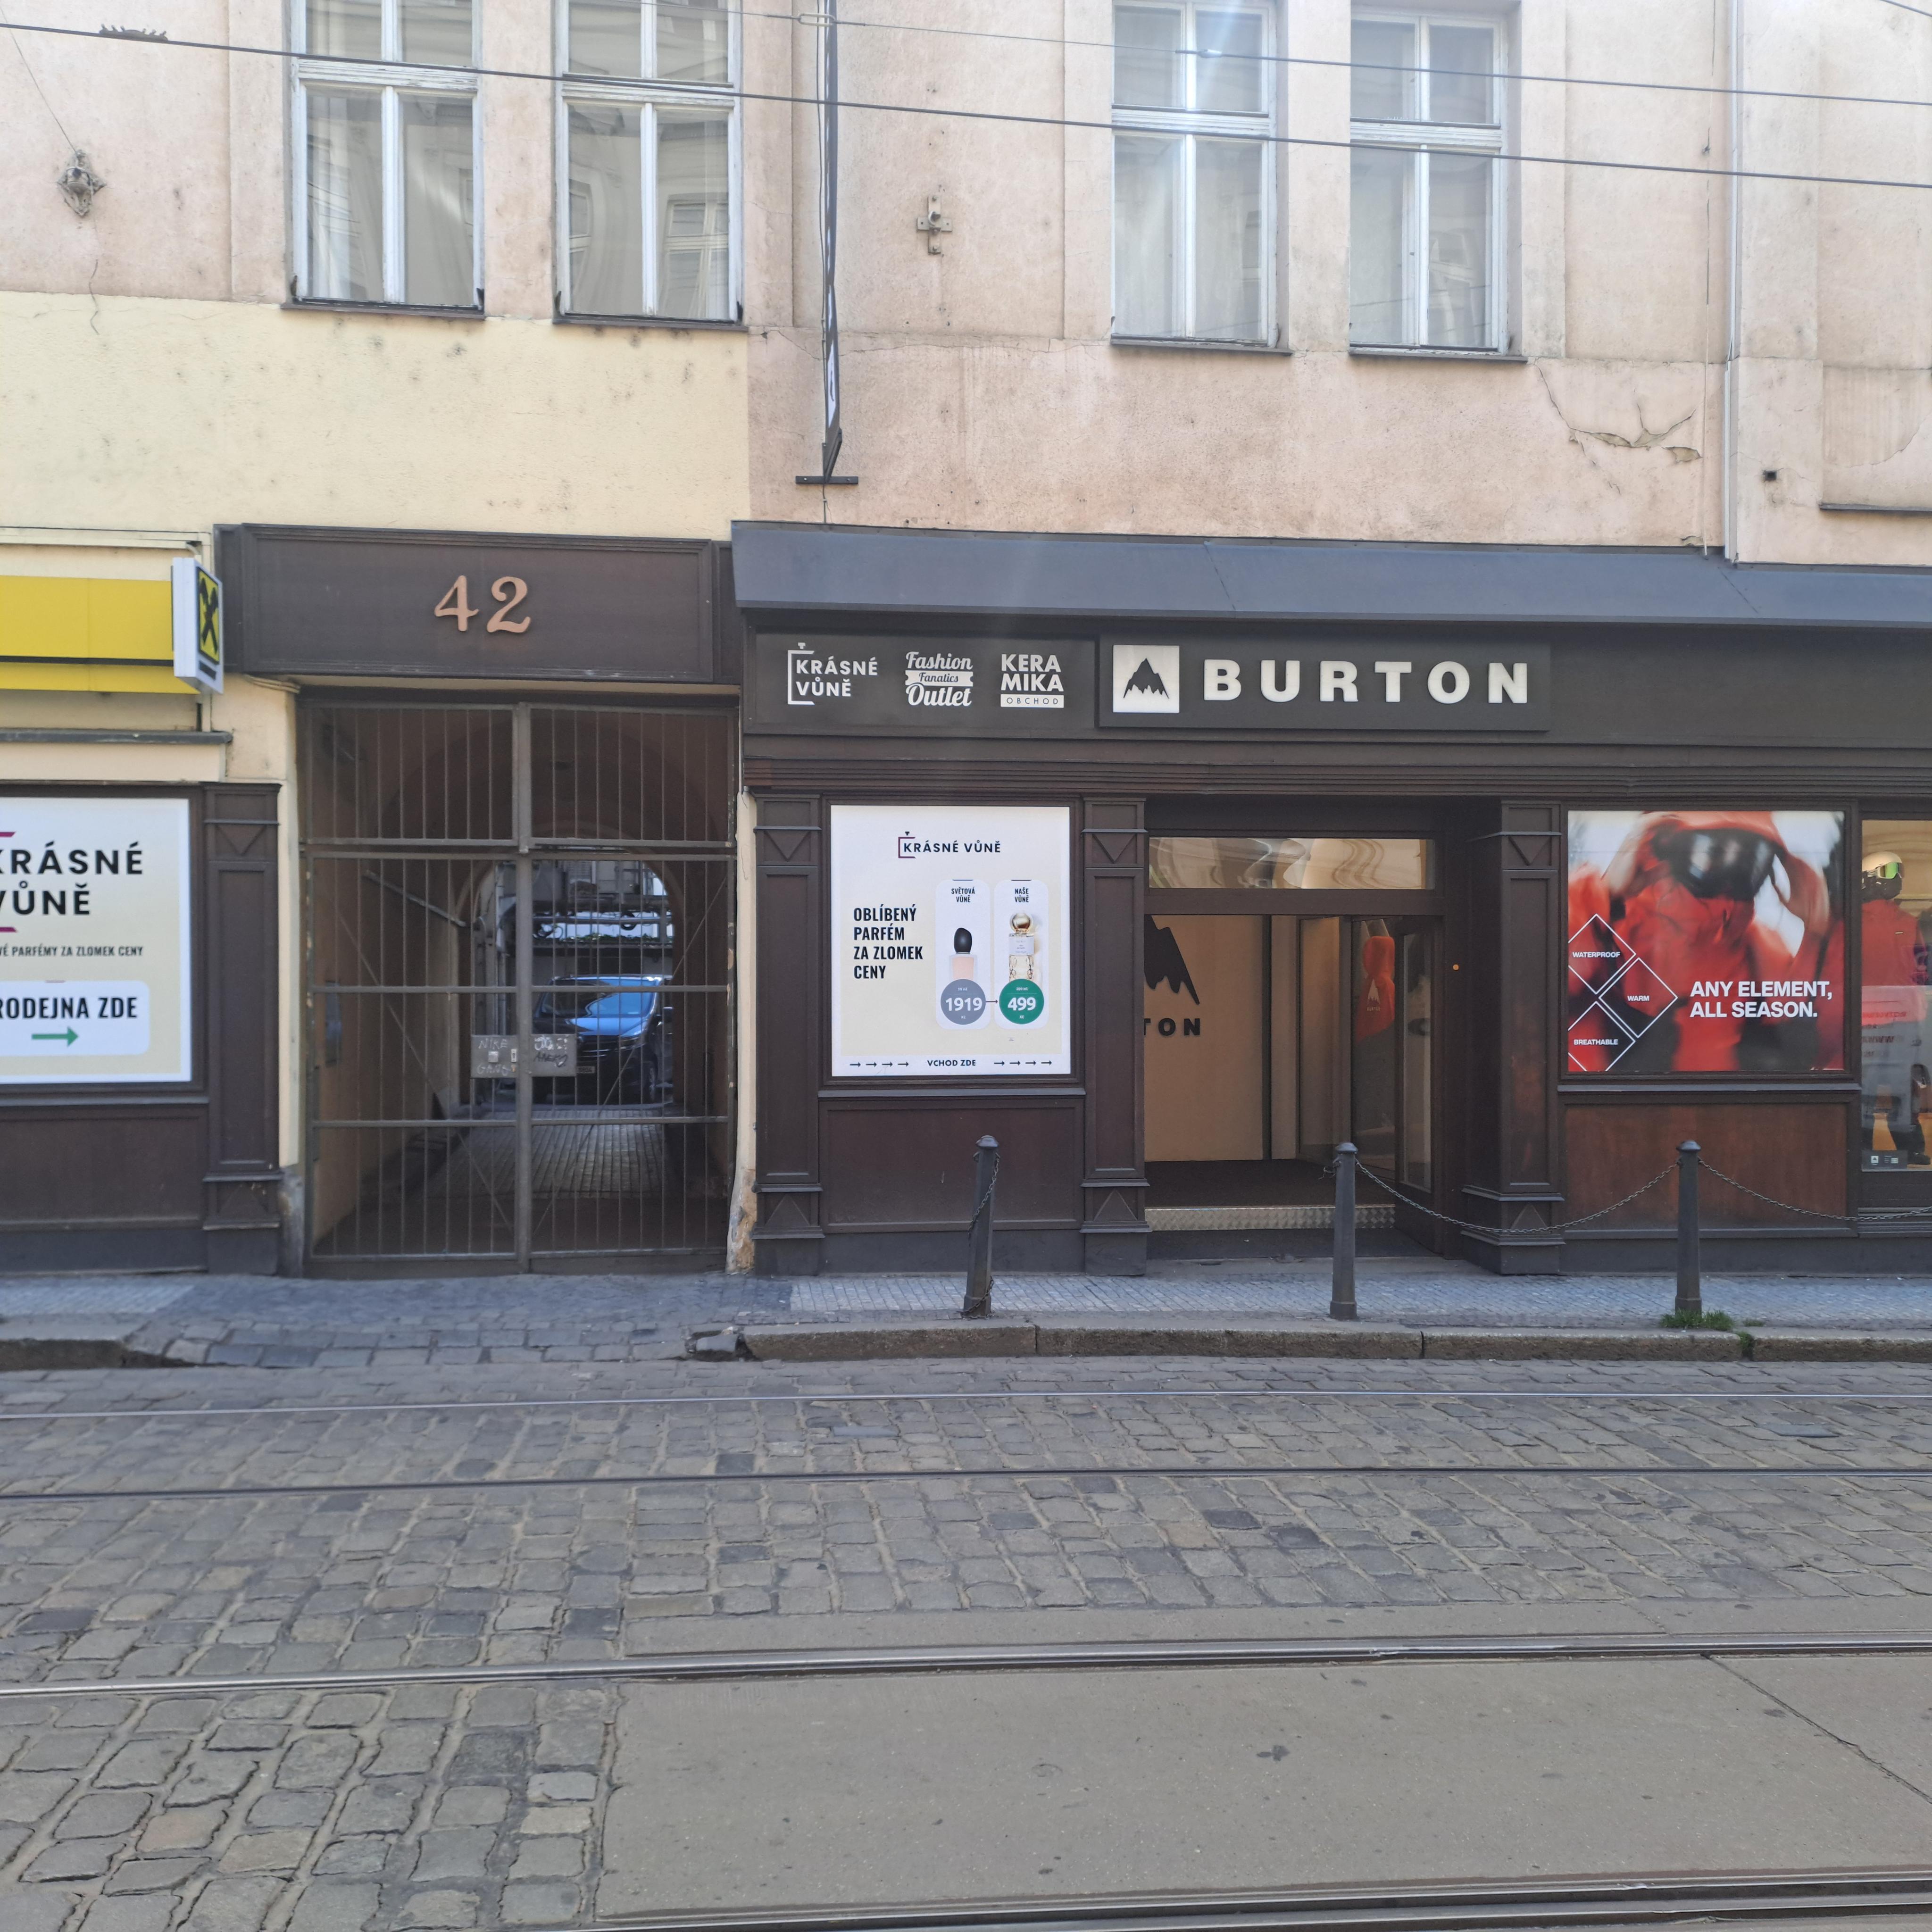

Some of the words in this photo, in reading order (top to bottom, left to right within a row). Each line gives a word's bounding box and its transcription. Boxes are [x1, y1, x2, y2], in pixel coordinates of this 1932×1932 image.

[434, 575, 531, 633] 42
[796, 656, 878, 675] KRÁSNÉ
[905, 651, 974, 670] Fashion
[1001, 654, 1062, 672] KERA
[918, 672, 959, 683] Fanatics
[1000, 673, 1064, 692] MIKA
[1204, 659, 1527, 704] BURTON
[796, 677, 852, 697] VŮNĚ
[905, 682, 972, 707] Outlet
[904, 840, 958, 853] KRÁSNÉ
[964, 840, 1000, 853] VŮNĚ
[853, 904, 916, 921] OBLÍBENÝ
[853, 923, 905, 941] PARFÉM
[12, 944, 58, 957] PARFÉMY
[61, 946, 72, 957] ZA
[76, 946, 115, 957] ZLOMEK
[118, 946, 143, 957] CENY
[853, 946, 869, 959] ZA
[873, 946, 923, 959] ZLOMEK
[854, 966, 886, 979] CENY
[1690, 981, 1733, 997] ANY
[1738, 981, 1832, 1000] ELEMENT,
[98, 997, 137, 1018] ZDE
[945, 997, 982, 1011] 1919
[1008, 997, 1036, 1011] 499
[1690, 1002, 1727, 1017] ALL
[1732, 1001, 1817, 1017] SEASON.
